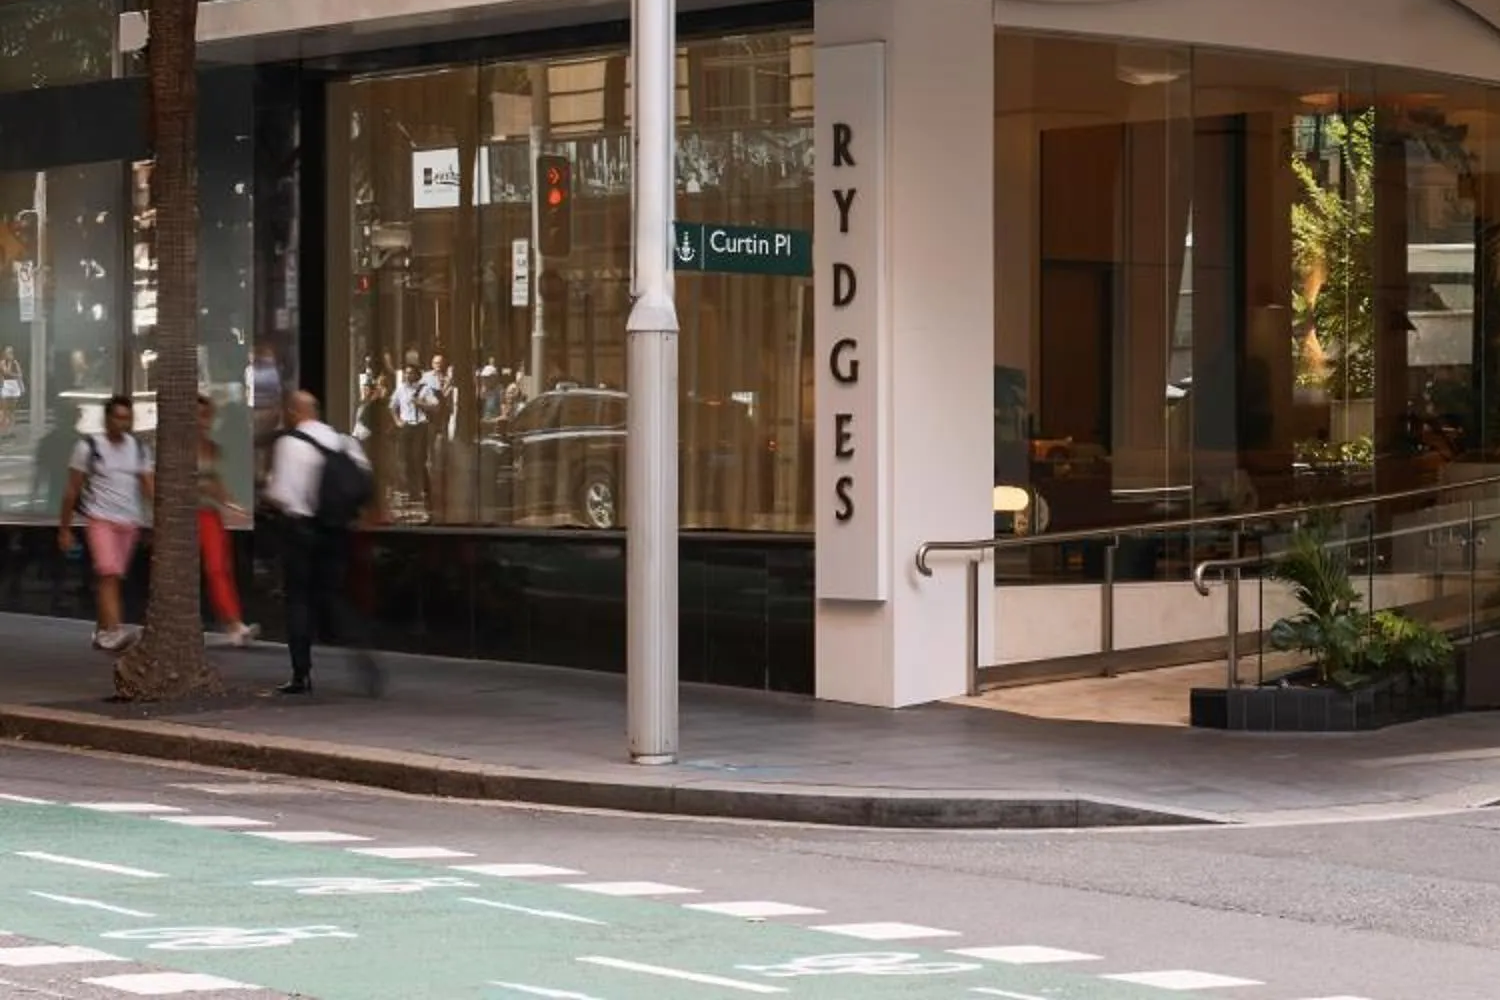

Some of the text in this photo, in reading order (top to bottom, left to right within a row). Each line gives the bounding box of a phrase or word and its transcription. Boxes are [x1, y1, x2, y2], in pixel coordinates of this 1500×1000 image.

[710, 229, 791, 257] Curtin Pl
[829, 122, 860, 522] RYDGES
